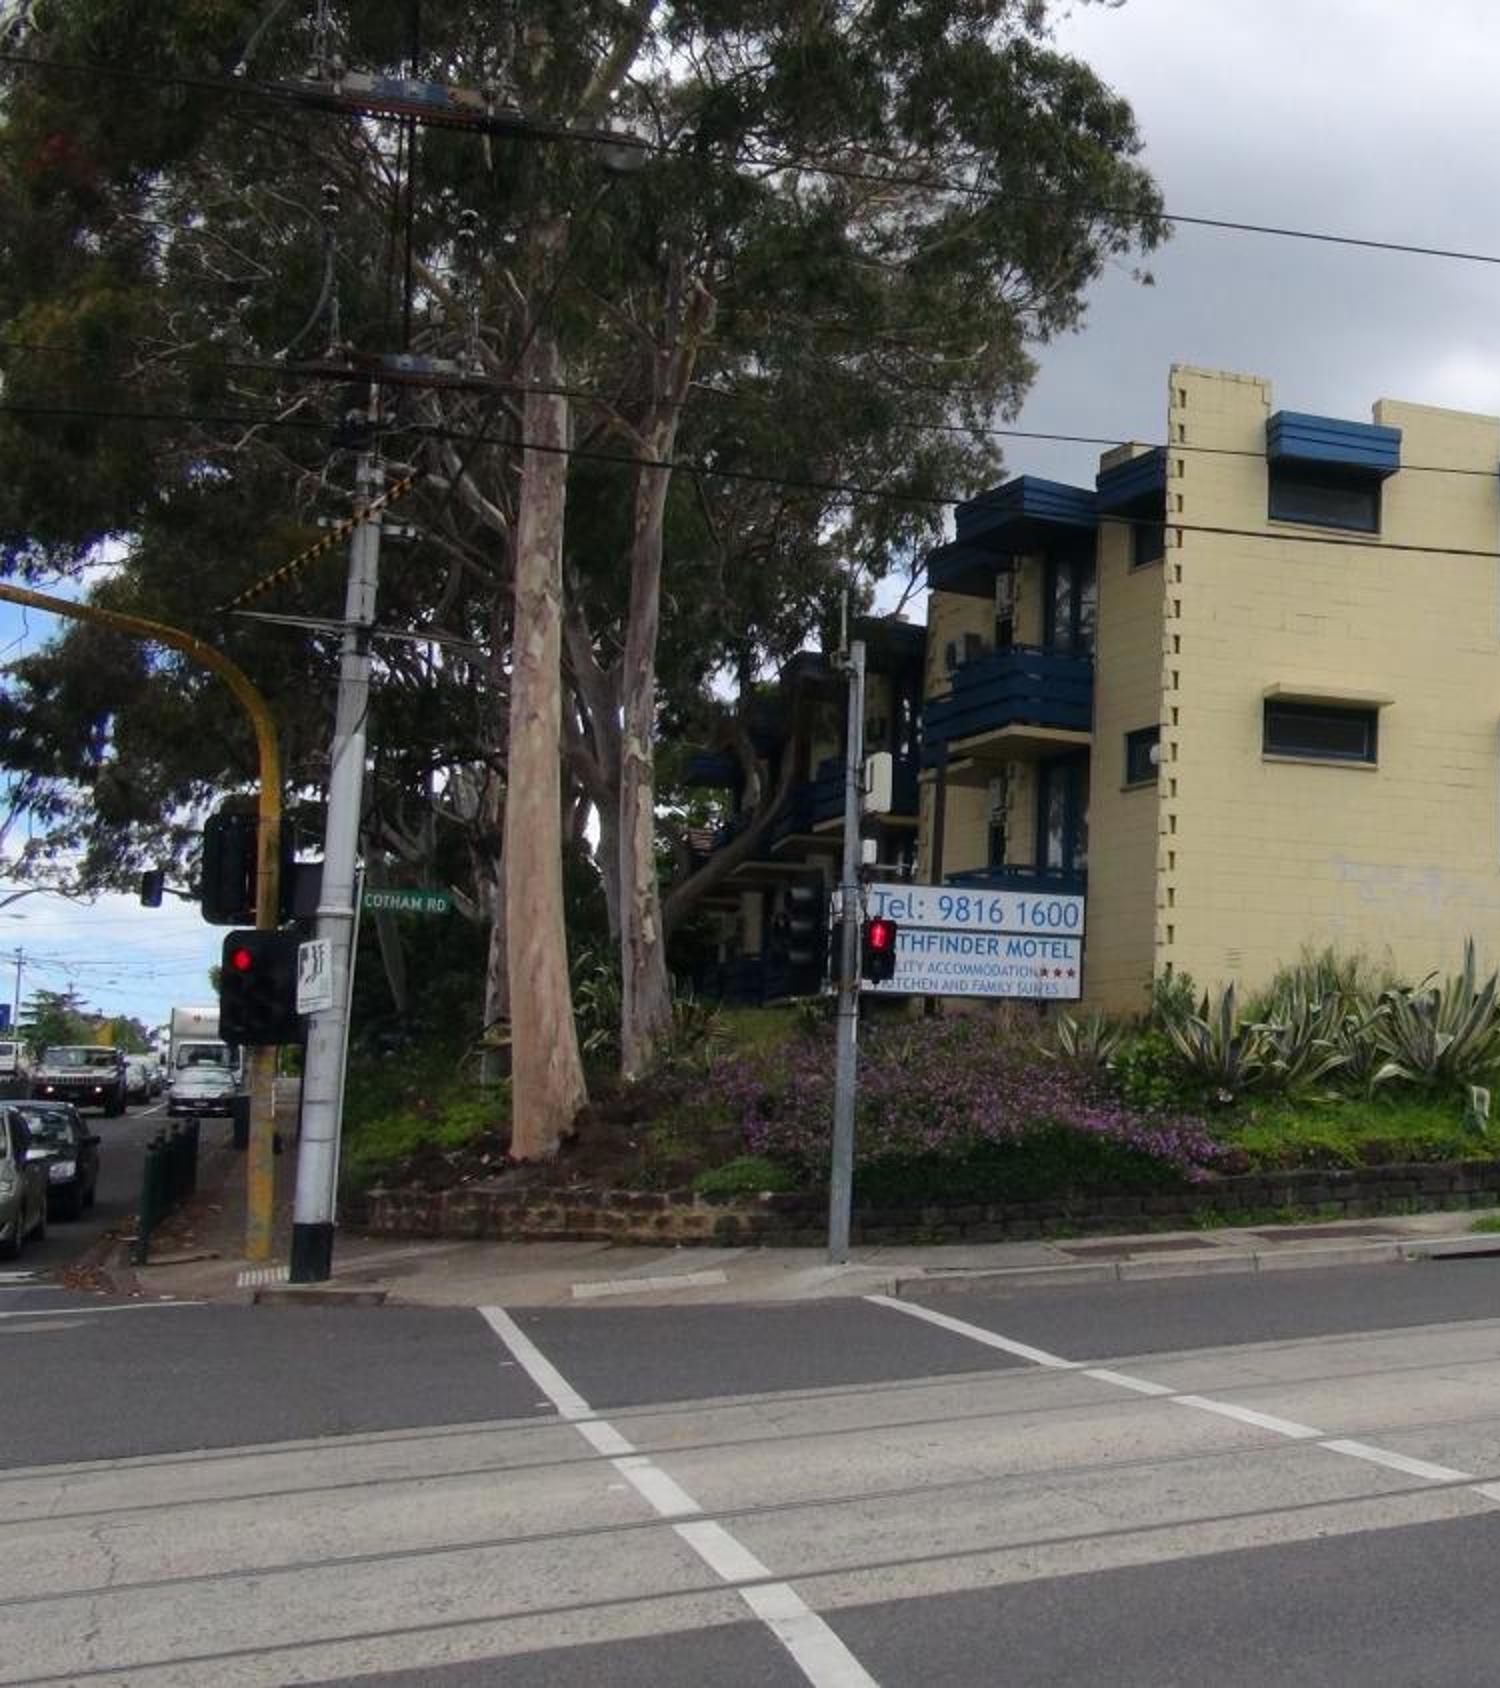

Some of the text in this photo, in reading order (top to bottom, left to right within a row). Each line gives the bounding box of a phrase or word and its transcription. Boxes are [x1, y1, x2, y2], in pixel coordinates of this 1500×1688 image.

[364, 893, 447, 912] COTHAM RD
[874, 891, 1079, 929] Tel: 9816 1600
[896, 933, 1073, 959] THFINDER MOTEL
[895, 960, 925, 973] LITY
[942, 979, 969, 992] AND
[973, 980, 1012, 993] FAMILY
